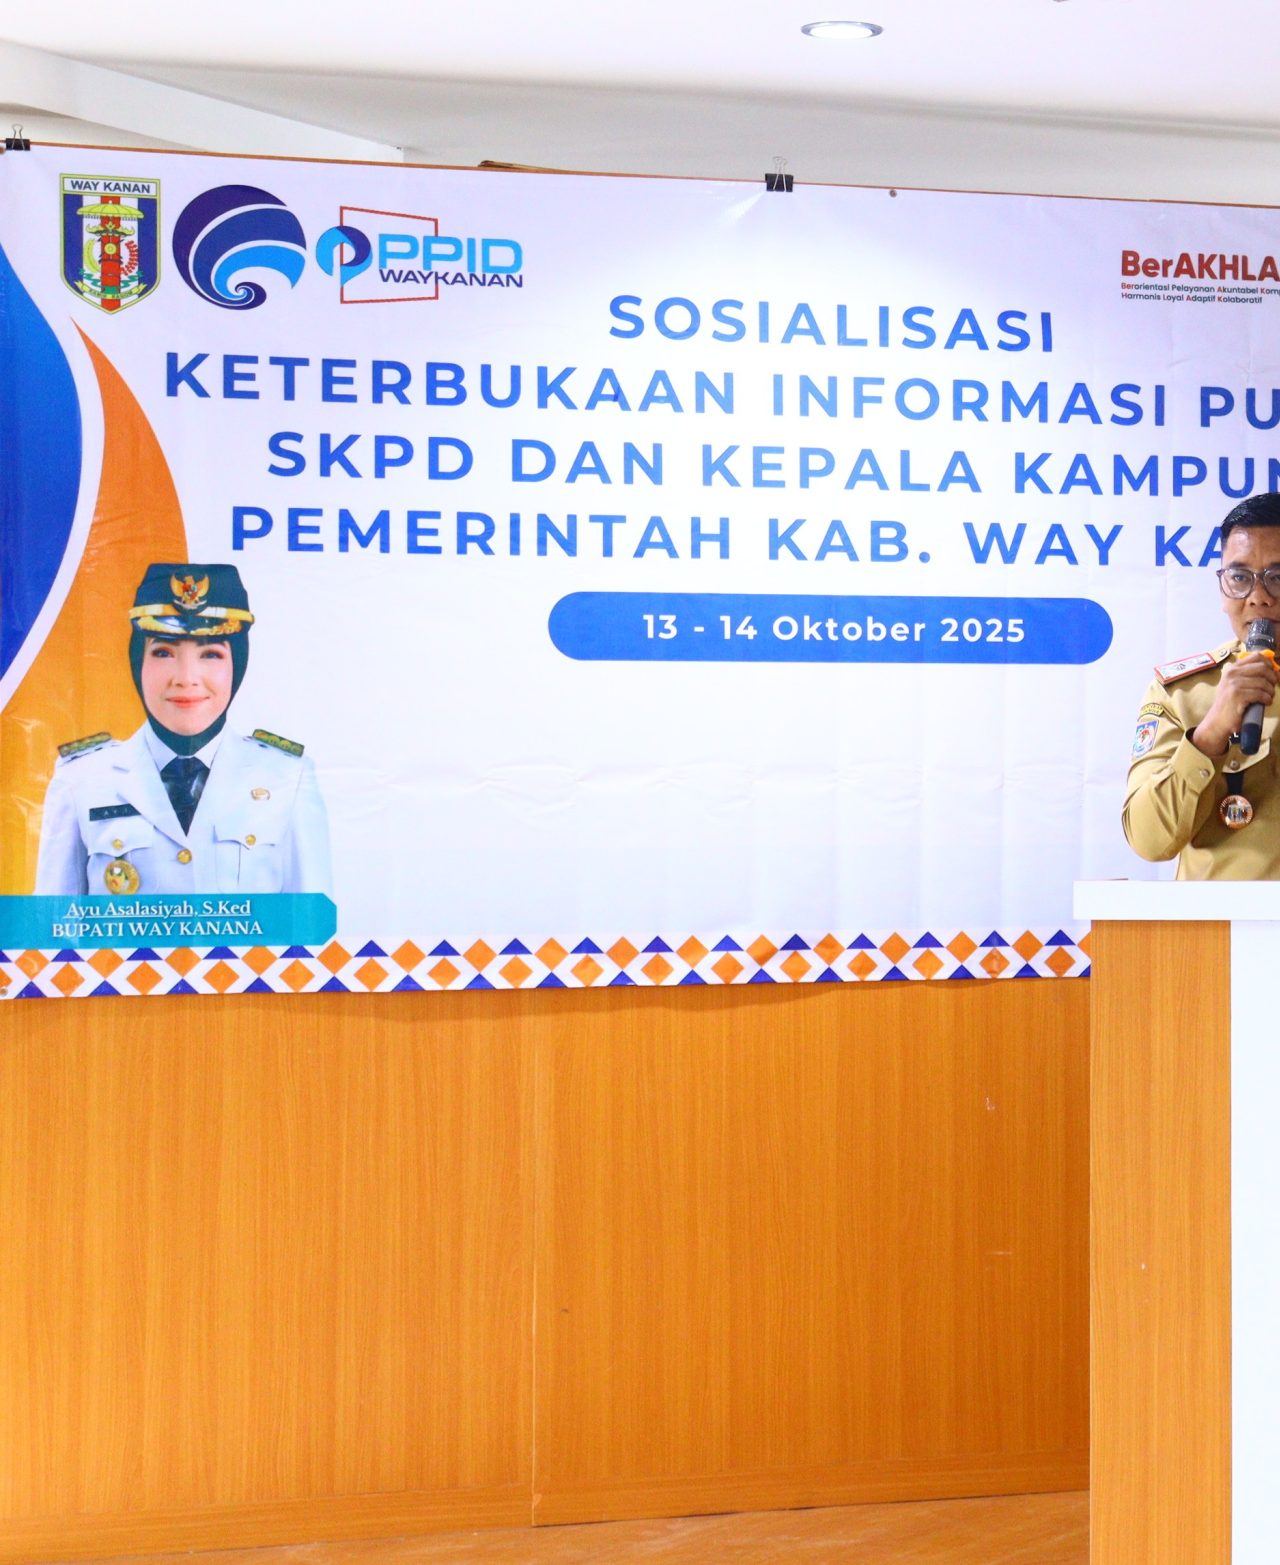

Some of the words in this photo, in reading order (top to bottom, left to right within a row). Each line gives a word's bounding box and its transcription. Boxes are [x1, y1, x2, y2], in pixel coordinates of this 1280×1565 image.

[71, 180, 99, 191] WAY
[103, 182, 151, 194] KANAN
[379, 233, 523, 274] PPID
[379, 269, 523, 288] WAYKANAN
[1121, 281, 1170, 292] Berorientasi
[1171, 283, 1215, 294] Pelayanan
[1217, 285, 1258, 294] Akuntabel
[1121, 292, 1161, 301] Harmonis
[1163, 293, 1184, 302] Loyal
[1186, 294, 1216, 303] Adaptif
[1217, 295, 1263, 304] Kolaboratif
[608, 294, 1053, 353] SOSIALISASI
[165, 351, 735, 414] KETERBUKAAN
[772, 374, 1166, 427] INFORMASI
[267, 431, 474, 481] SKPD
[511, 438, 664, 486] DAN
[702, 444, 982, 493] KEPALA
[231, 505, 735, 560] PEMERINTAH
[768, 518, 931, 564] KAB.
[963, 521, 1124, 567] WAY
[643, 614, 678, 639] 13
[719, 615, 758, 640] 14
[772, 615, 926, 641] Oktober
[940, 618, 1025, 643] 2025
[64, 903, 100, 920] Ayu
[104, 901, 199, 919] Asalasiyah,
[202, 900, 250, 917] S.Ked
[52, 922, 124, 938] BUPATI
[128, 921, 175, 937] WAY
[179, 920, 263, 936] KANANA
